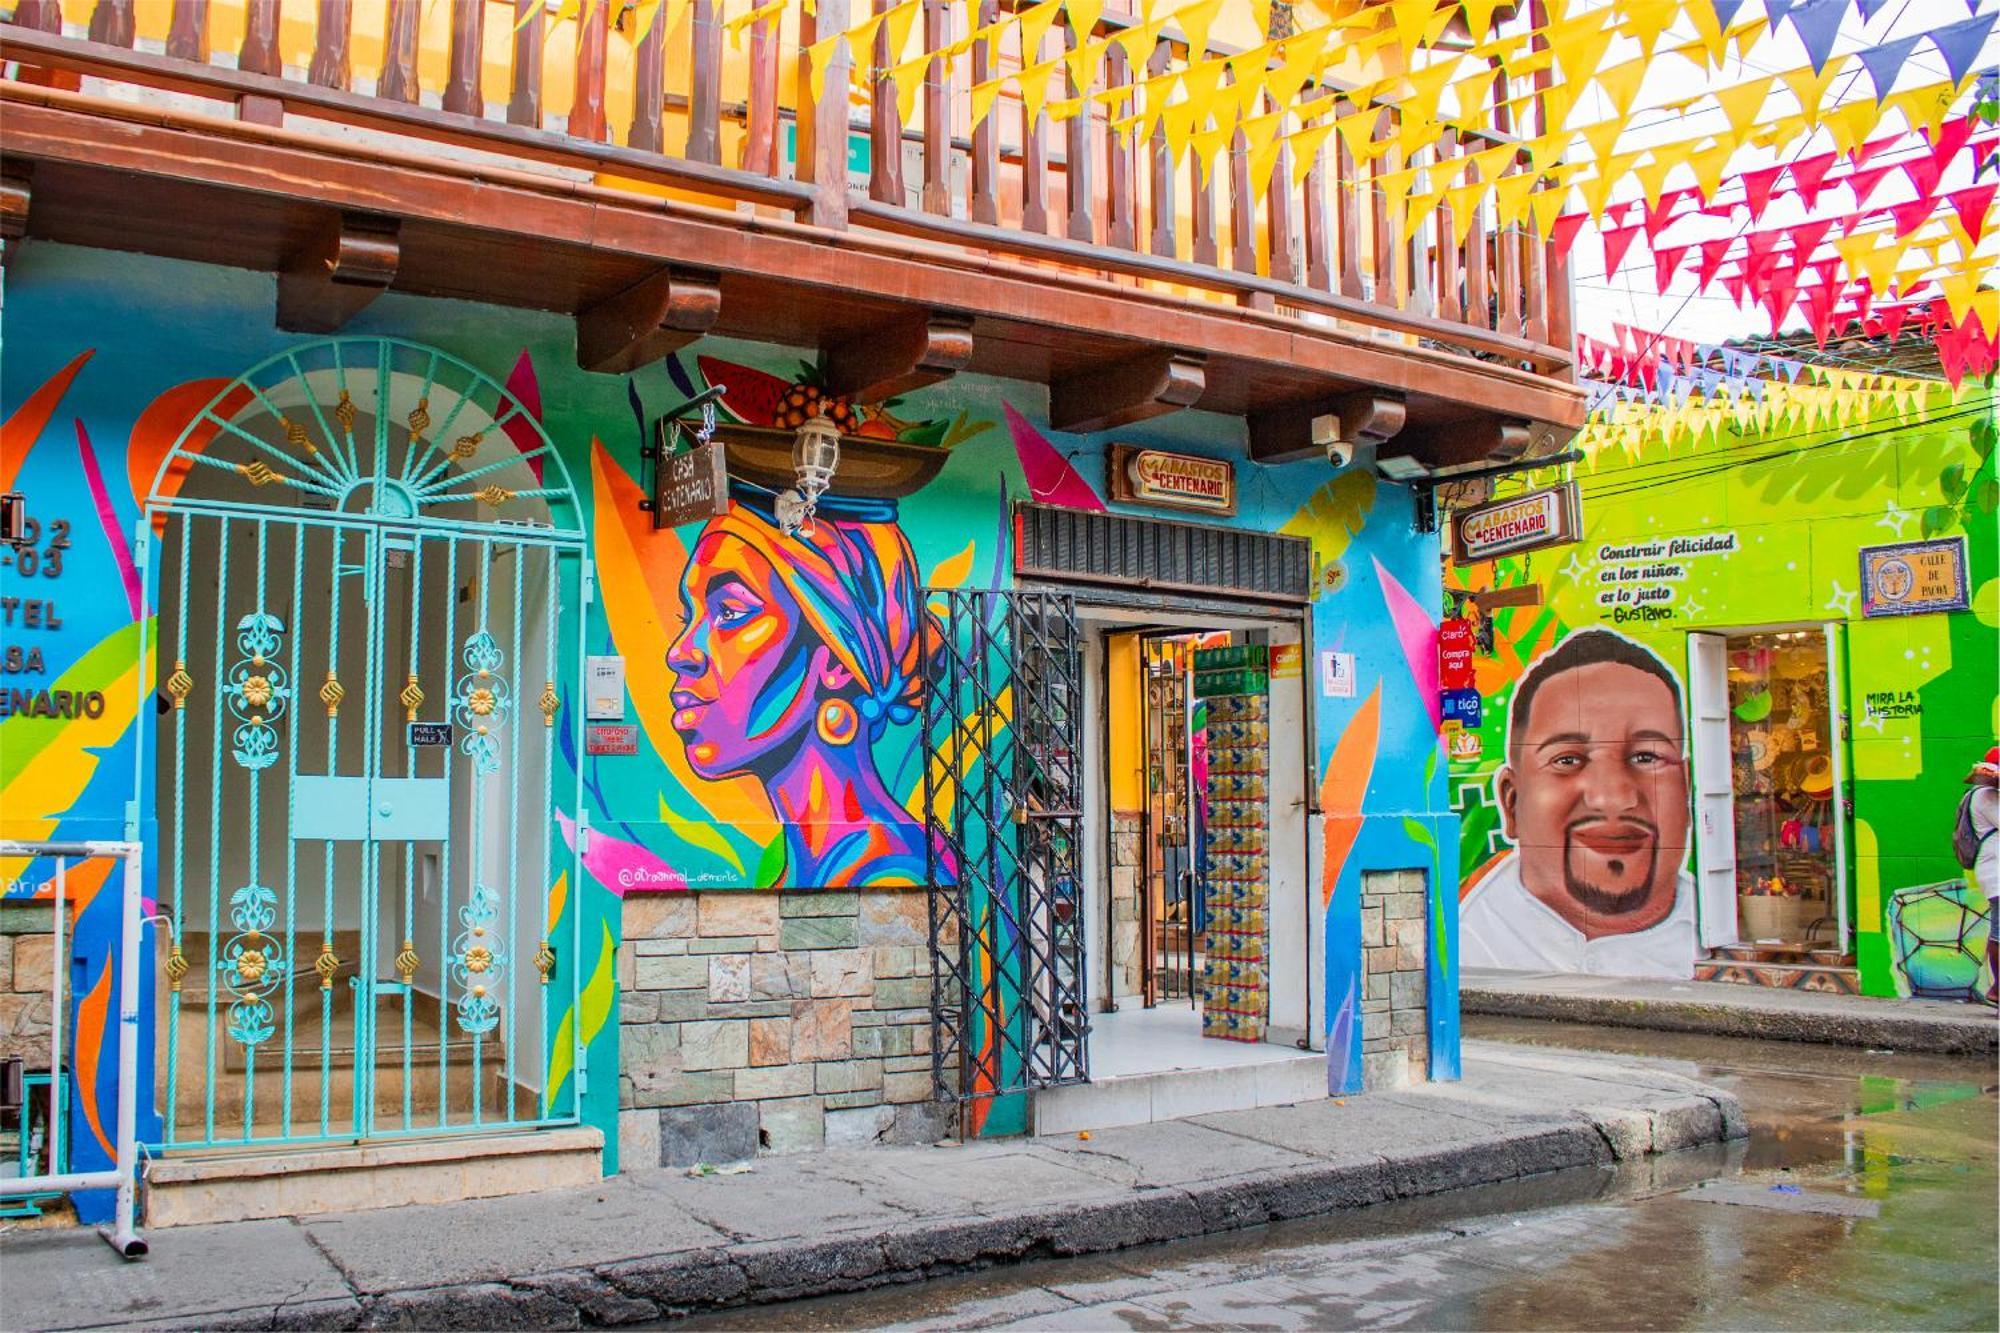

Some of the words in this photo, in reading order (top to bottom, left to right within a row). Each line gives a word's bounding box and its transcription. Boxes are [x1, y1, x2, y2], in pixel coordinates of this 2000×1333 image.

[1160, 459, 1223, 480] ABASTOS
[1160, 472, 1223, 496] CENTENARIO
[1484, 501, 1543, 529] ABASTOS
[1483, 514, 1546, 543] CENTENARIO
[1600, 544, 1665, 560] Construir
[1668, 534, 1734, 557] felicidad
[1920, 554, 1946, 566] CALLE
[1601, 572, 1616, 582] en
[1619, 567, 1639, 580] los
[1929, 570, 1939, 581] DE
[1601, 594, 1614, 603] es
[1617, 589, 1630, 602] lo
[1633, 587, 1670, 605] justo
[1442, 629, 1464, 640] Claro
[0, 645, 45, 674] SA
[1442, 650, 1470, 659] Compra
[1867, 692, 1895, 703] MIRA
[1899, 691, 1914, 703] LA
[1867, 703, 1924, 716] HISTORIA
